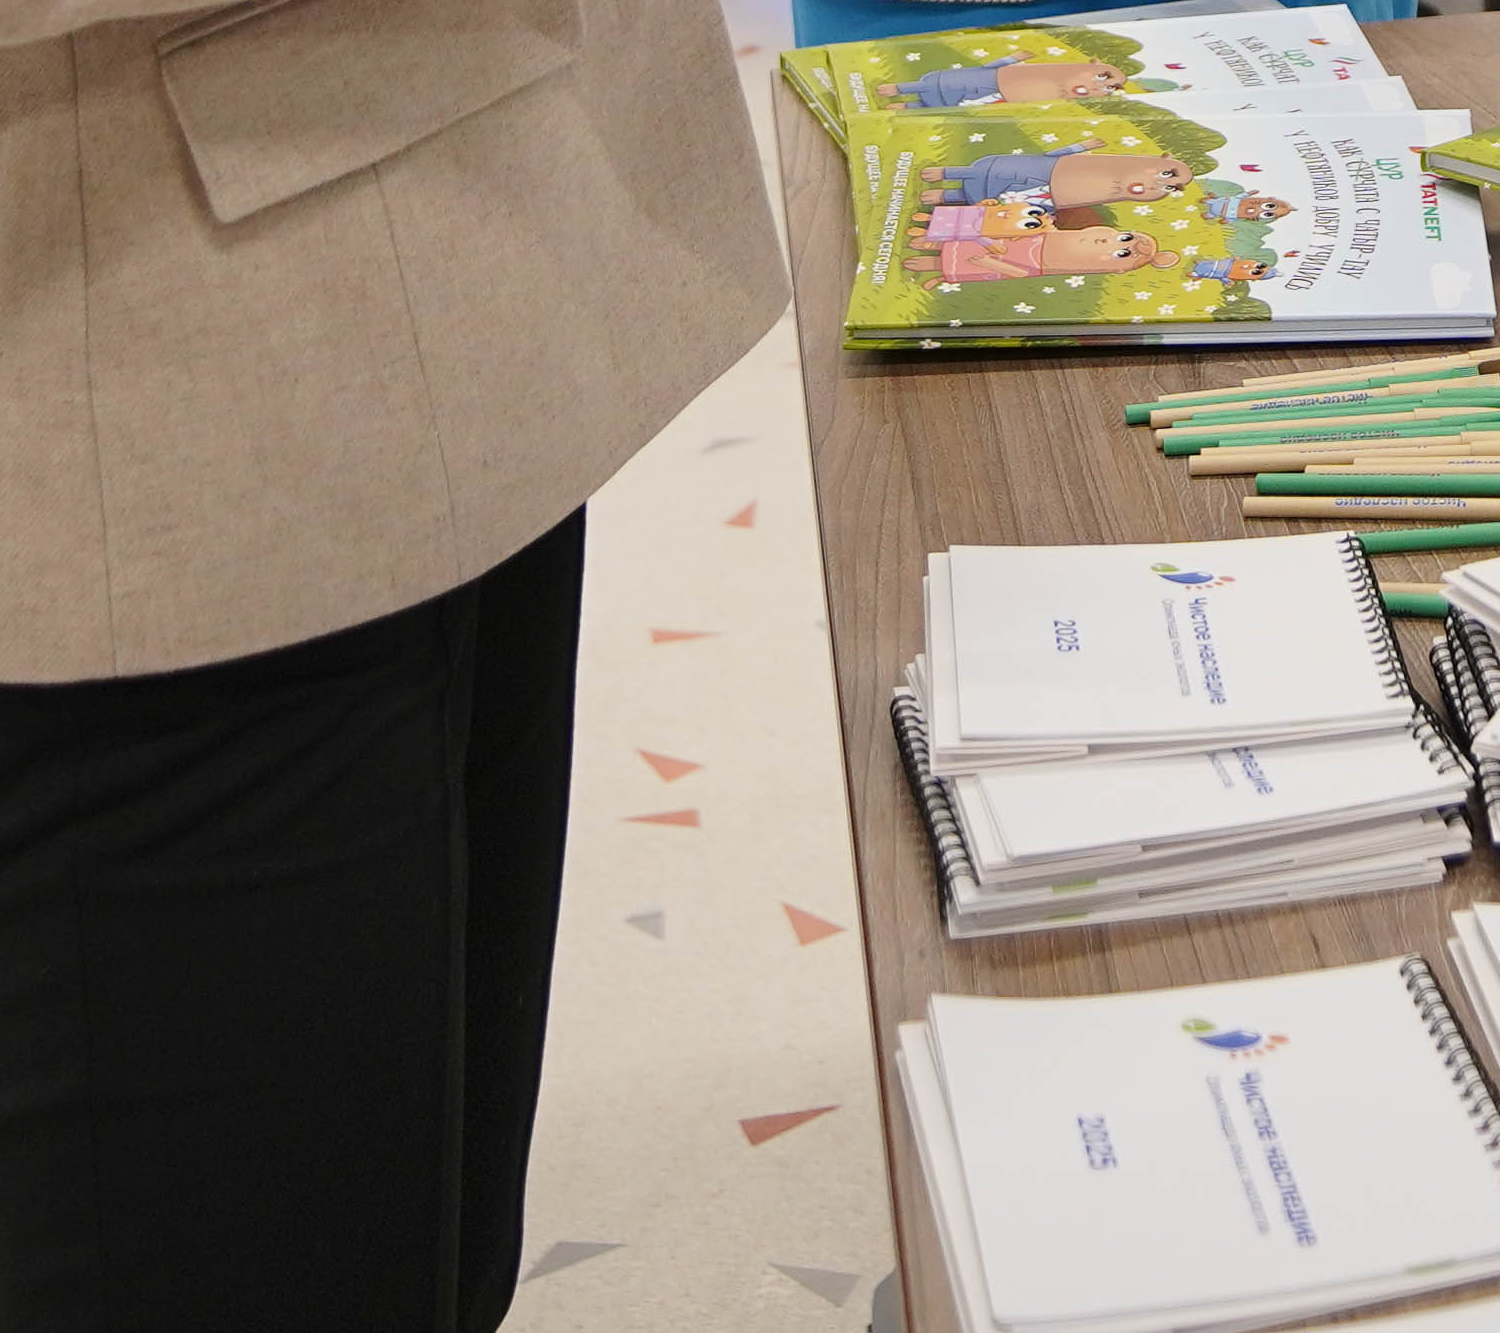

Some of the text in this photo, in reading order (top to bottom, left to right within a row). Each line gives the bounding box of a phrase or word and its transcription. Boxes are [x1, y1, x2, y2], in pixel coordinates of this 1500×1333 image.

[1235, 35, 1270, 53] КАК
[1282, 48, 1316, 68] ЦУР
[864, 144, 882, 179] БУДУЩЕЕ
[1294, 140, 1339, 201] НЕФТЯНИКОВ
[1331, 138, 1364, 158] КАК
[1371, 157, 1405, 180] ЦУР
[871, 151, 914, 286] БУДУЩЕЕ НАЧИНАЕТСЯ СЕГОДНЯ!
[1312, 205, 1340, 238] ДОБРУ
[1420, 181, 1442, 242] TATNEFT
[1284, 244, 1335, 291] УЧИЛИСЬ
[1337, 219, 1381, 279] ЧАТЫР-ТАУ
[1052, 619, 1081, 653] 2025
[1188, 596, 1227, 706] Чистое наследие
[1076, 1112, 1119, 1171] 2025
[1239, 1068, 1318, 1249] Чистое наследие
